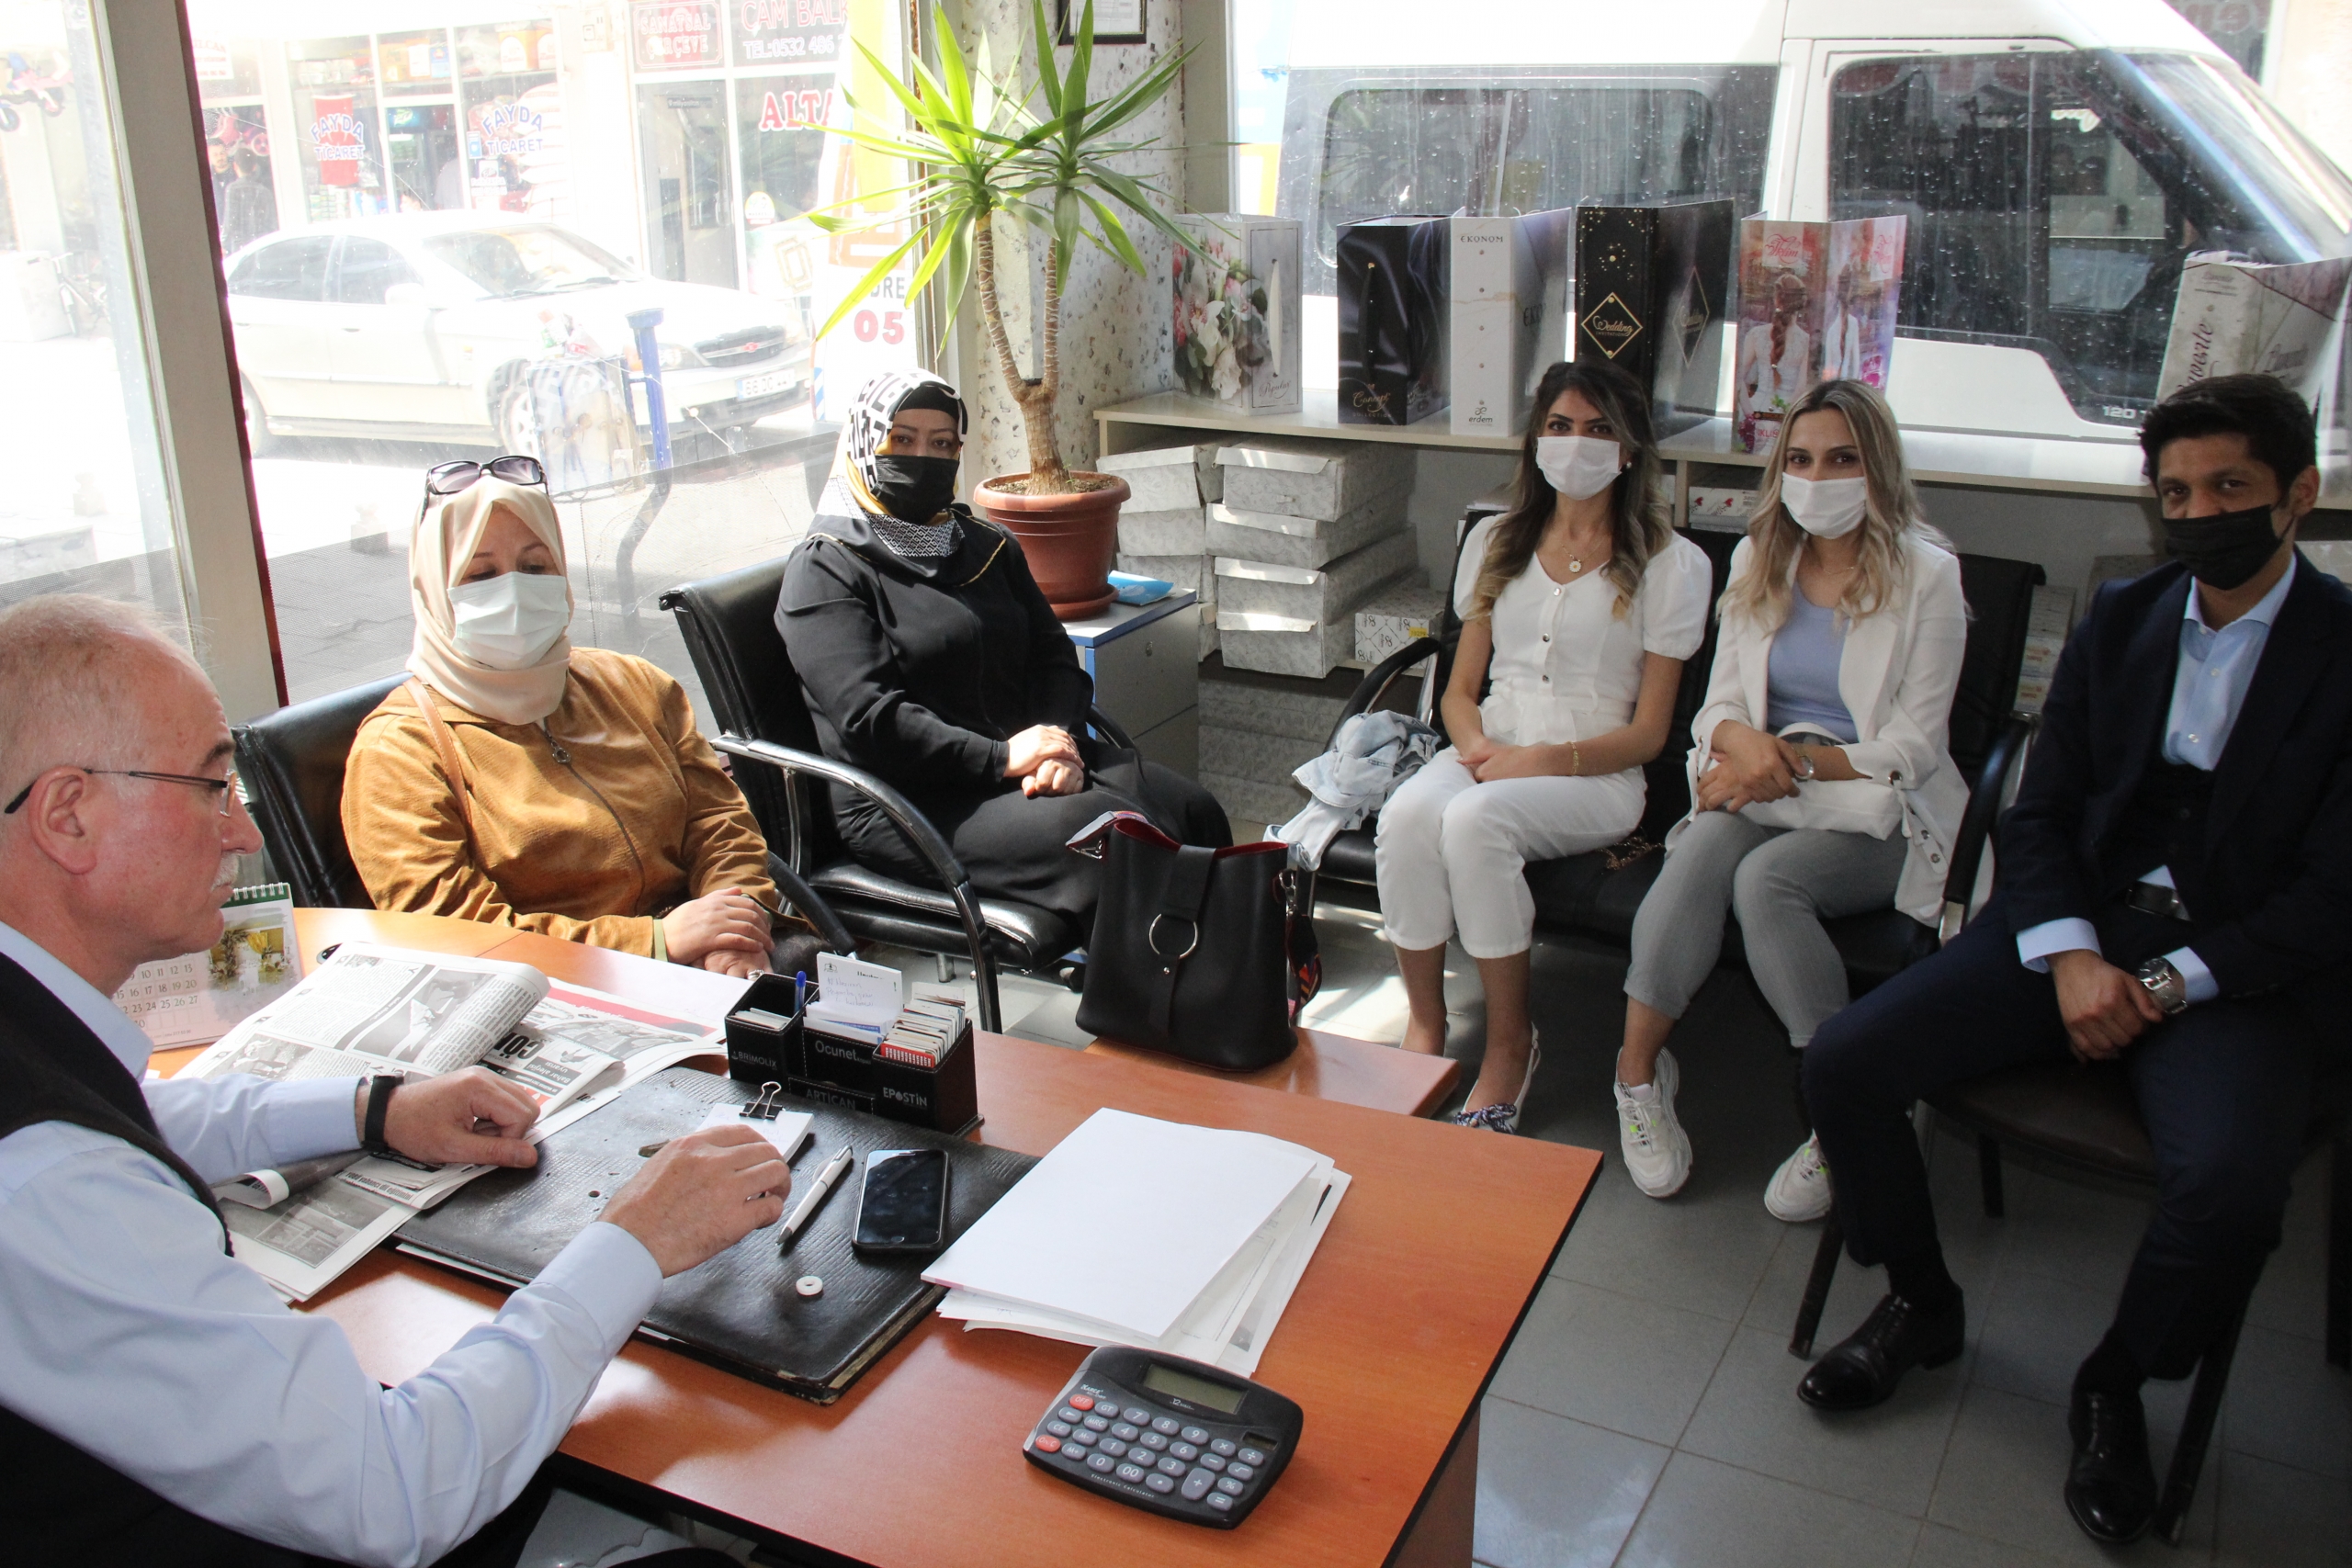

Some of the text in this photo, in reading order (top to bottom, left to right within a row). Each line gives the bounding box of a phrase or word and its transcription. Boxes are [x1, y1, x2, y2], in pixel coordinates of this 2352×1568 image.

[641, 13, 711, 35] SANATSAL
[646, 35, 708, 60] ÇRÇEVE
[482, 105, 544, 136] FAYDA
[311, 113, 365, 141] FAYDA
[487, 137, 544, 155] TİCARET
[314, 144, 366, 161] TİCARET
[1460, 235, 1504, 243] EKONOM
[1592, 315, 1634, 337] Wedding
[2102, 405, 2136, 419] 120
[1468, 415, 1493, 423] erdem
[141, 970, 152, 979] 10
[157, 968, 164, 976] 11
[170, 966, 178, 975] 12
[184, 964, 193, 973] 13
[116, 979, 197, 999] 15 16 17 18 19 20
[132, 1004, 142, 1013] 23
[146, 1001, 157, 1011] 24
[160, 999, 171, 1009] 25
[174, 998, 185, 1007] 26
[188, 996, 198, 1004] 27
[815, 1040, 858, 1061] Ocunet
[1074, 1396, 1090, 1404] OFF
[1133, 1411, 1143, 1419] 7
[1087, 1417, 1105, 1427] MRC
[1161, 1420, 1170, 1429] 8
[1053, 1424, 1065, 1432] CE
[1121, 1427, 1130, 1435] 4
[1191, 1429, 1200, 1438] 9
[1148, 1435, 1159, 1444] 5
[1110, 1442, 1117, 1450] 1
[1179, 1445, 1188, 1454] 6
[1136, 1450, 1147, 1461] 2
[1095, 1457, 1105, 1466] 0
[1167, 1461, 1176, 1470] 3
[1122, 1466, 1139, 1478] 00
[1091, 1473, 1155, 1498] Electronic Calculator
